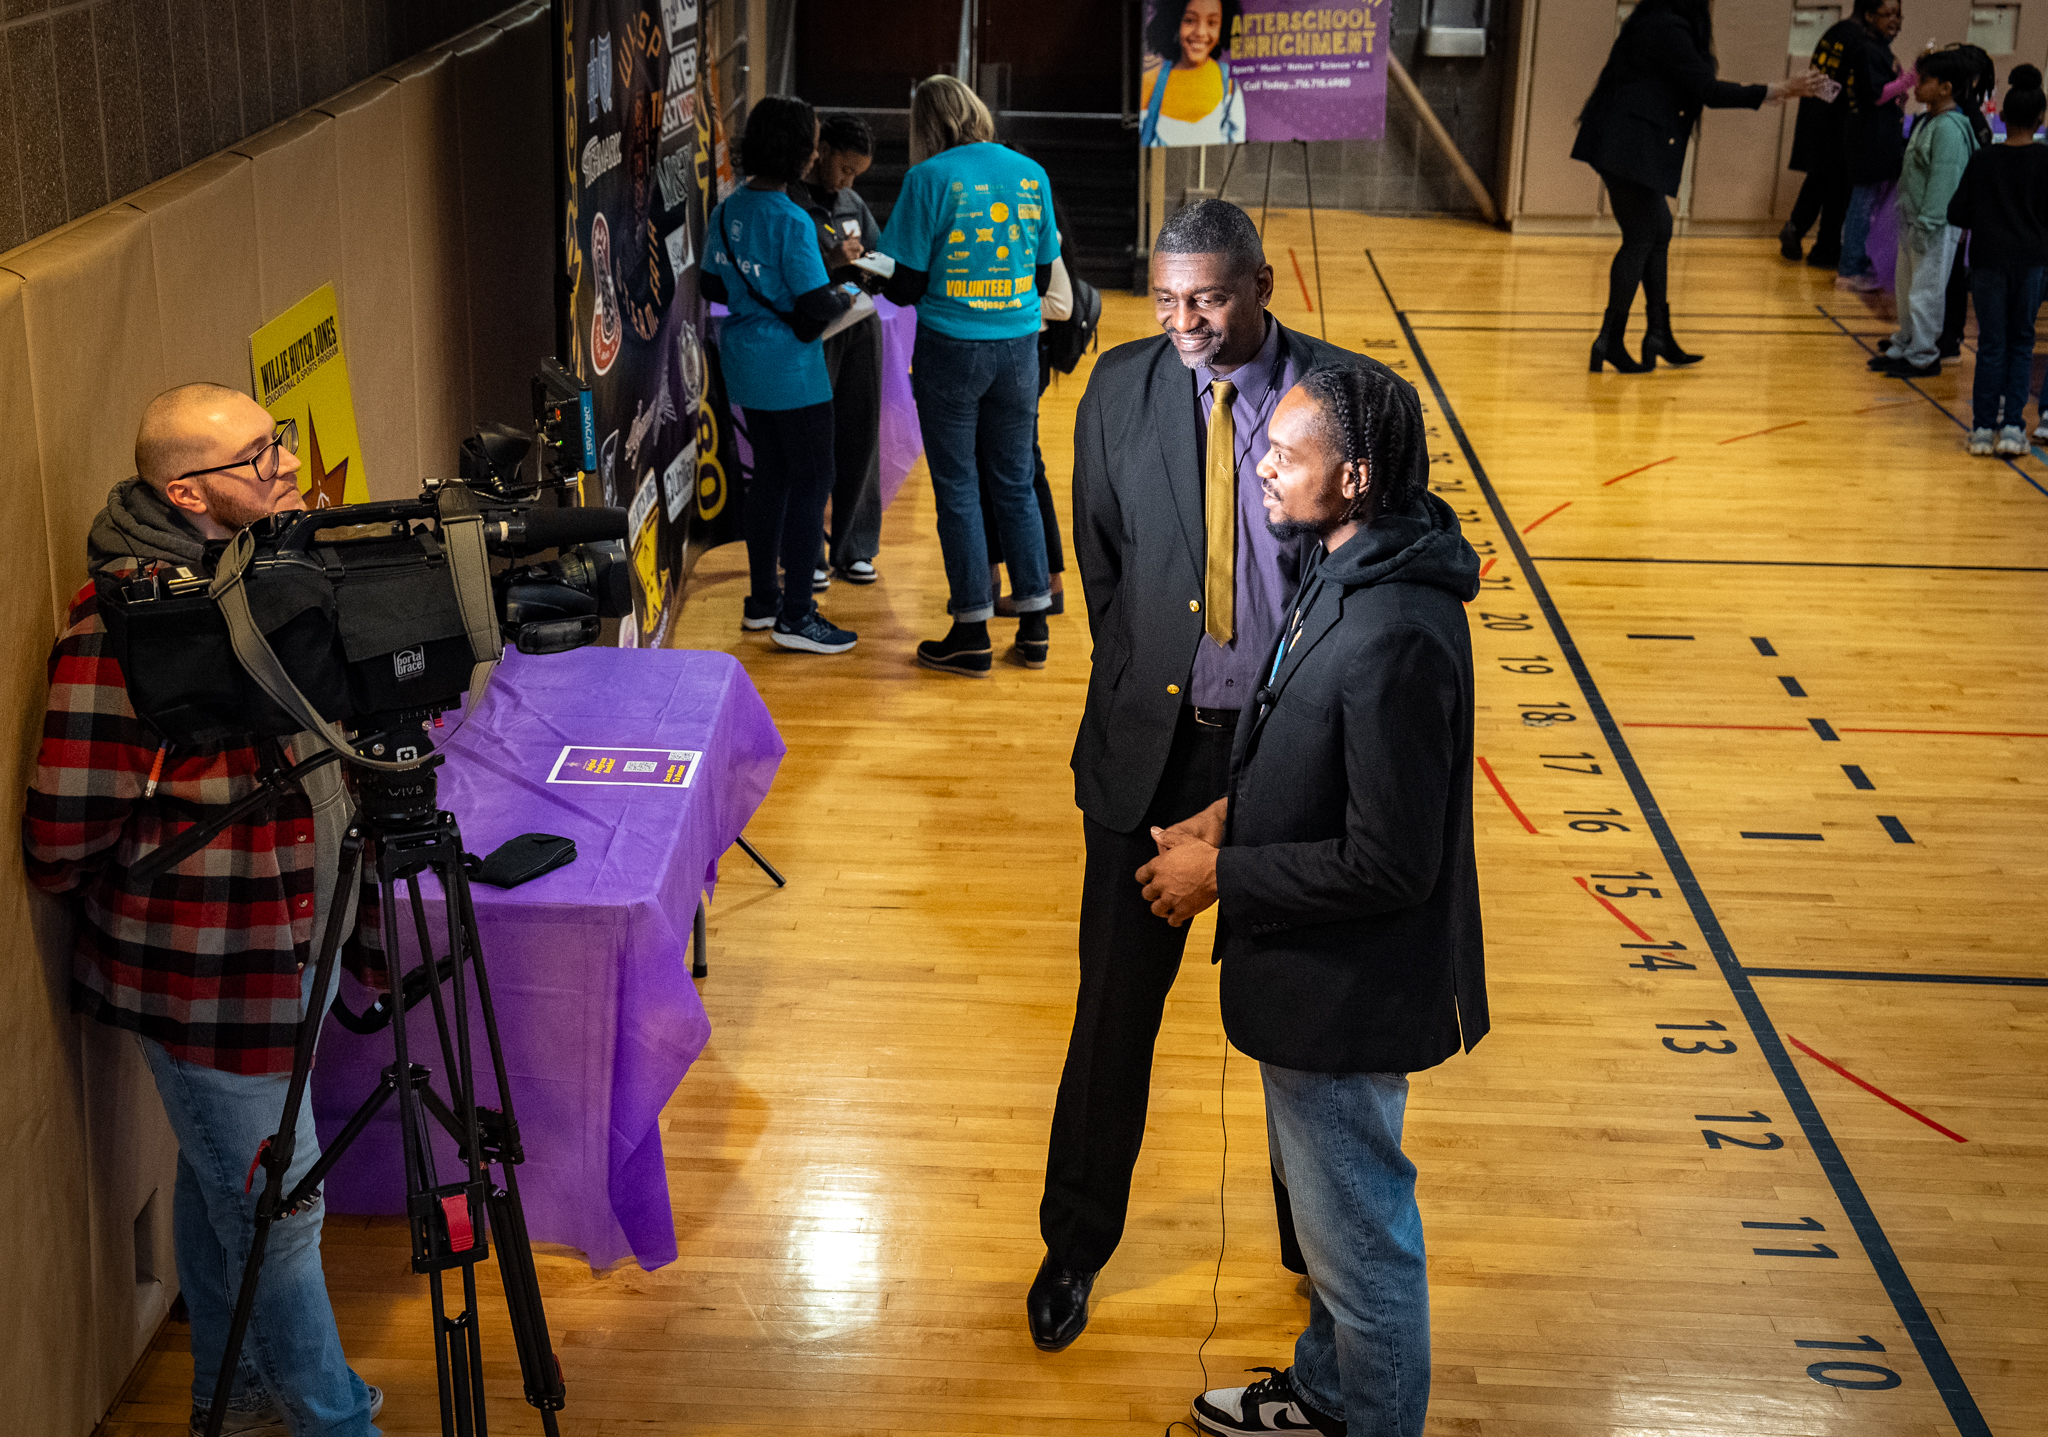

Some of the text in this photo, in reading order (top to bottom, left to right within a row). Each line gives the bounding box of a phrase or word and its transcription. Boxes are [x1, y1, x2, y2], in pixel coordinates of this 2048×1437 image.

[1230, 8, 1376, 35] AFTERSCHOOL
[1230, 30, 1376, 60] ENRICHMENT
[1260, 63, 1282, 72] Music
[1287, 62, 1314, 71] Nature
[1320, 61, 1350, 70] Science
[1356, 60, 1370, 69] Art
[1243, 80, 1261, 91] Call
[946, 280, 1012, 297] VOLUNTEER
[261, 316, 337, 396] WILLIE HUTCH JONES
[266, 345, 339, 408] EDUCATIONAL & SPORTS PROGRAM
[584, 406, 594, 457] DRACAST
[1479, 612, 1534, 631] 20
[397, 652, 422, 666] porta
[398, 661, 422, 675] brace
[1498, 655, 1554, 674] 19
[1518, 702, 1576, 722] 18
[1540, 752, 1603, 774] 17
[388, 785, 423, 797] WIVB
[1564, 808, 1630, 832] 16
[1590, 870, 1662, 899] 15
[1620, 940, 1696, 971] 14
[1656, 1020, 1738, 1054] 13
[1694, 1110, 1784, 1150] 12
[1741, 1216, 1840, 1259] 11
[1794, 1335, 1902, 1391] 10
